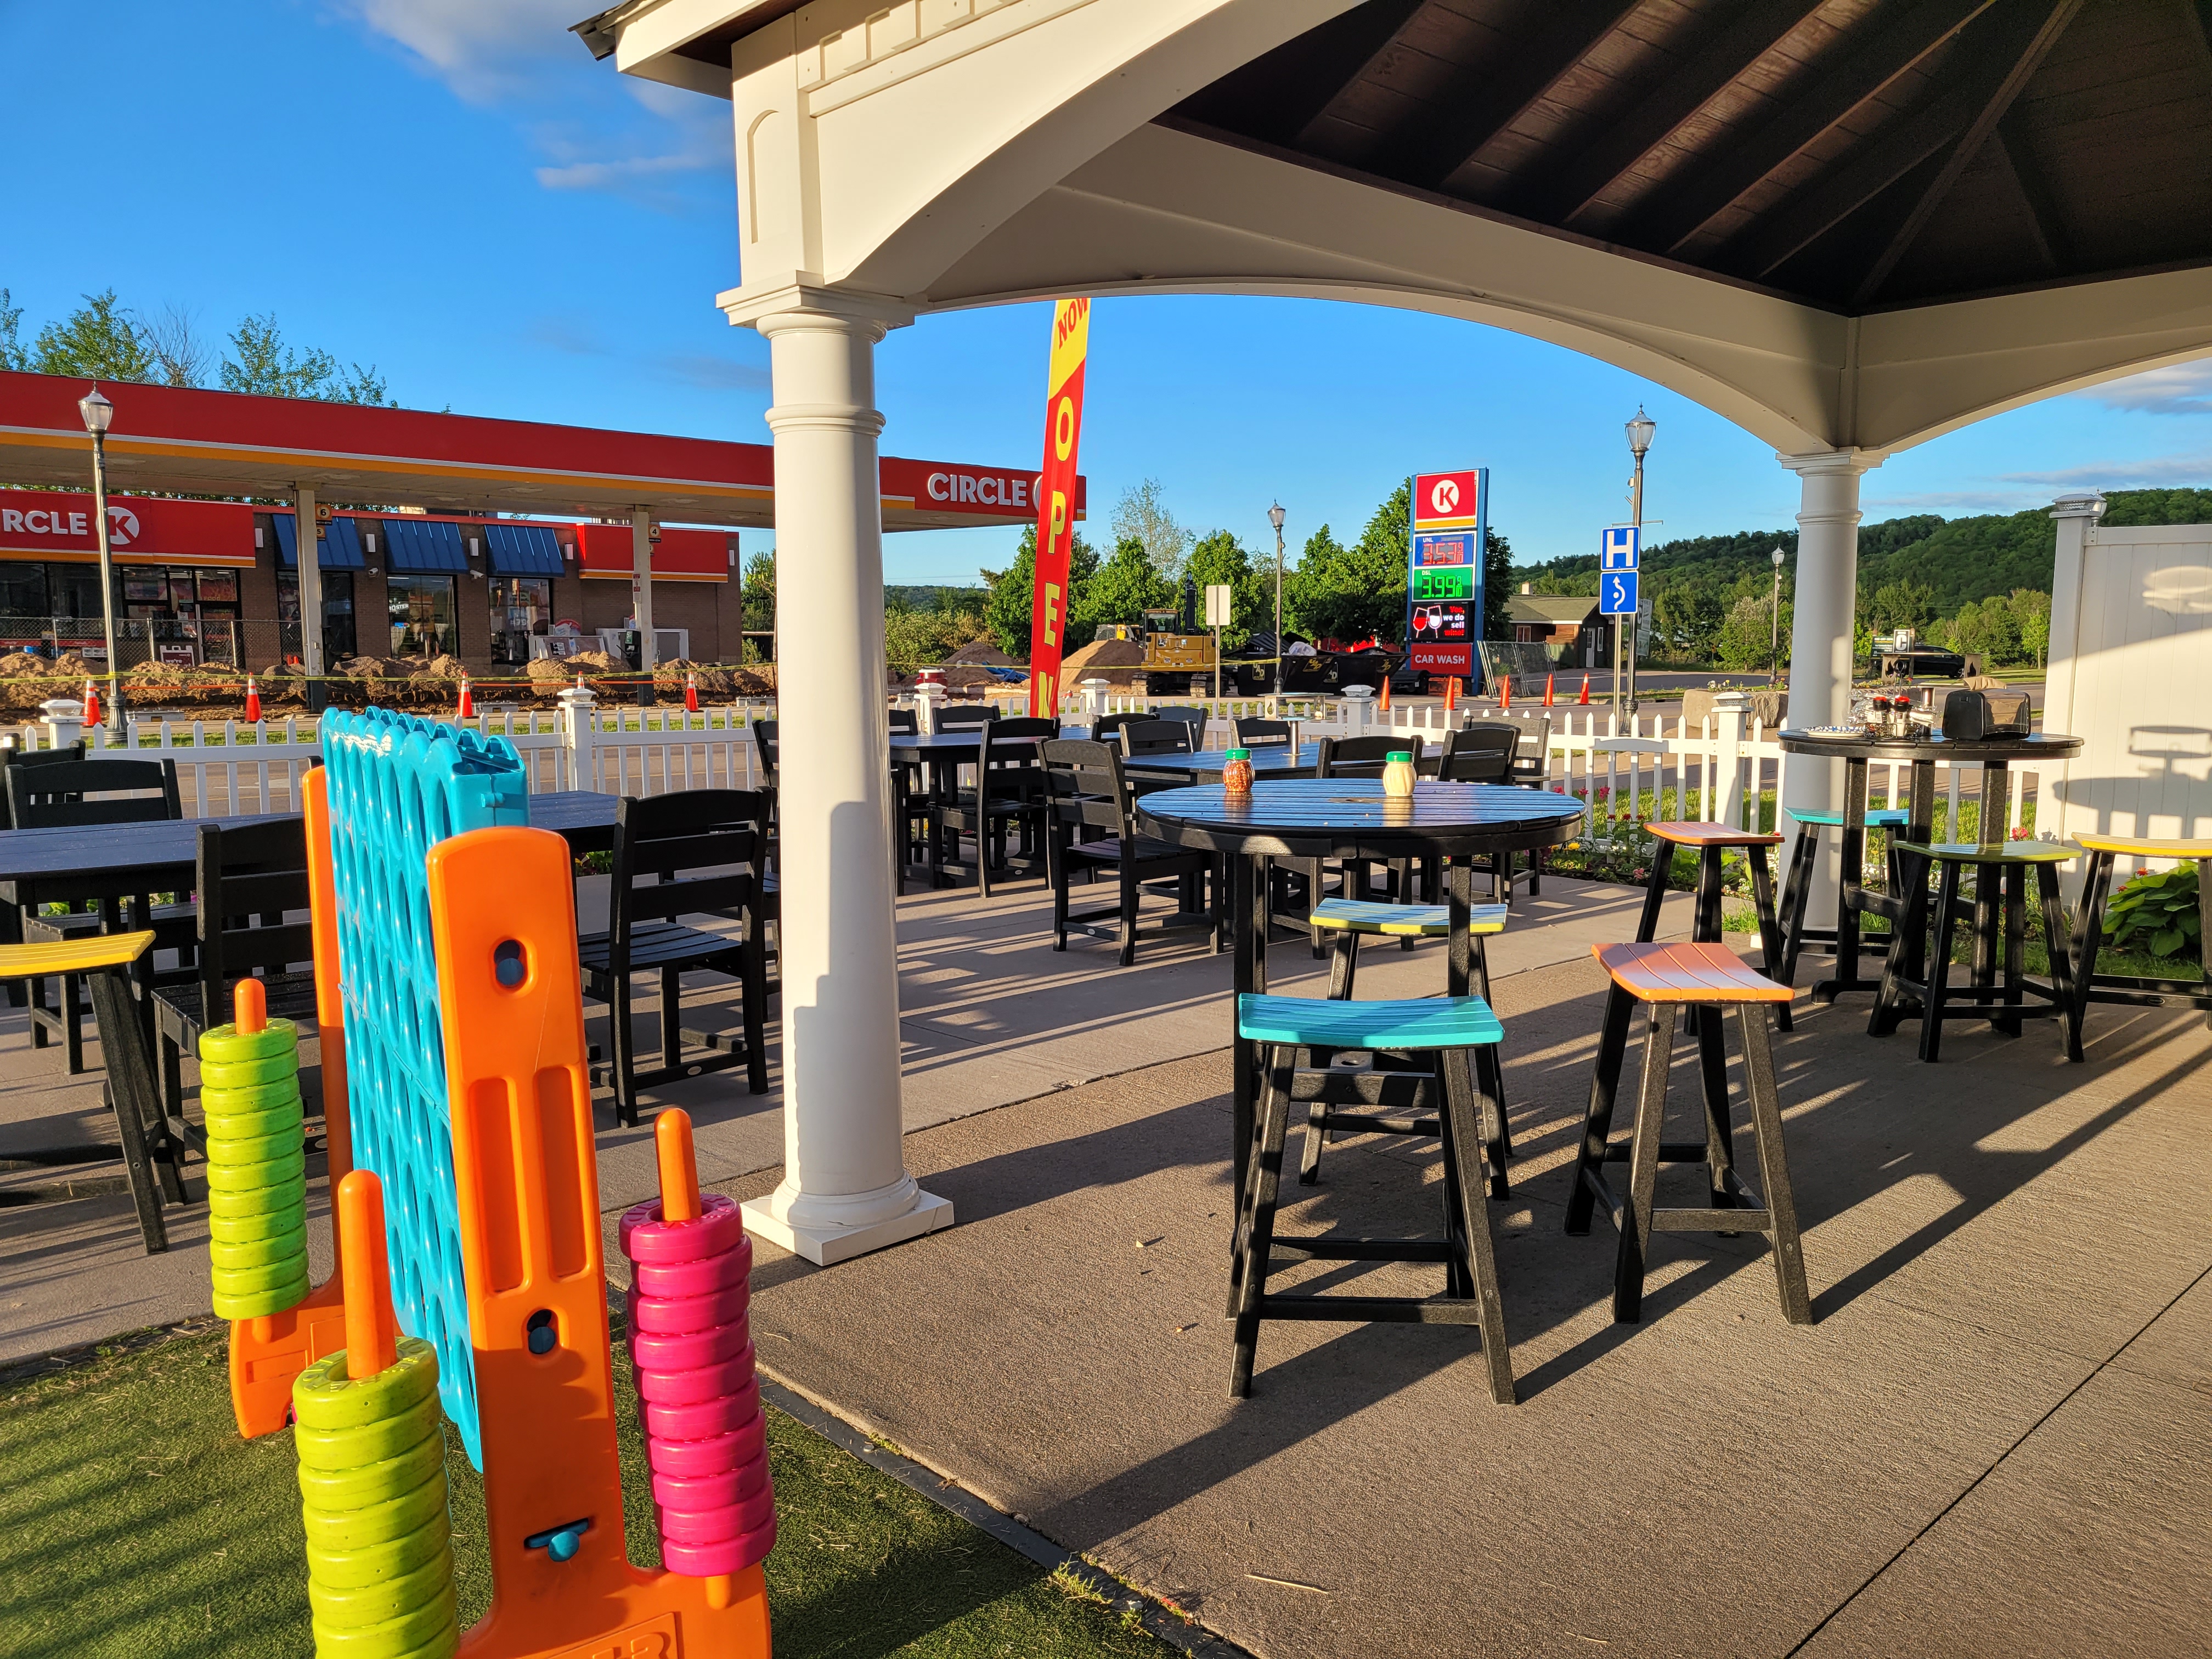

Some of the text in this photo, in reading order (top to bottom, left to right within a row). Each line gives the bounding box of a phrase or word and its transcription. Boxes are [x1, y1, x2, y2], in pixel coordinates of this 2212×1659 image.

[1057, 297, 1088, 351] NOW
[927, 472, 1028, 507] CIRCLE
[1038, 396, 1074, 719] OPEN
[1423, 543, 1457, 566] 3.53
[1606, 529, 1634, 568] H
[1422, 576, 1456, 598] 3.99
[1415, 654, 1465, 664] CAR WASH
